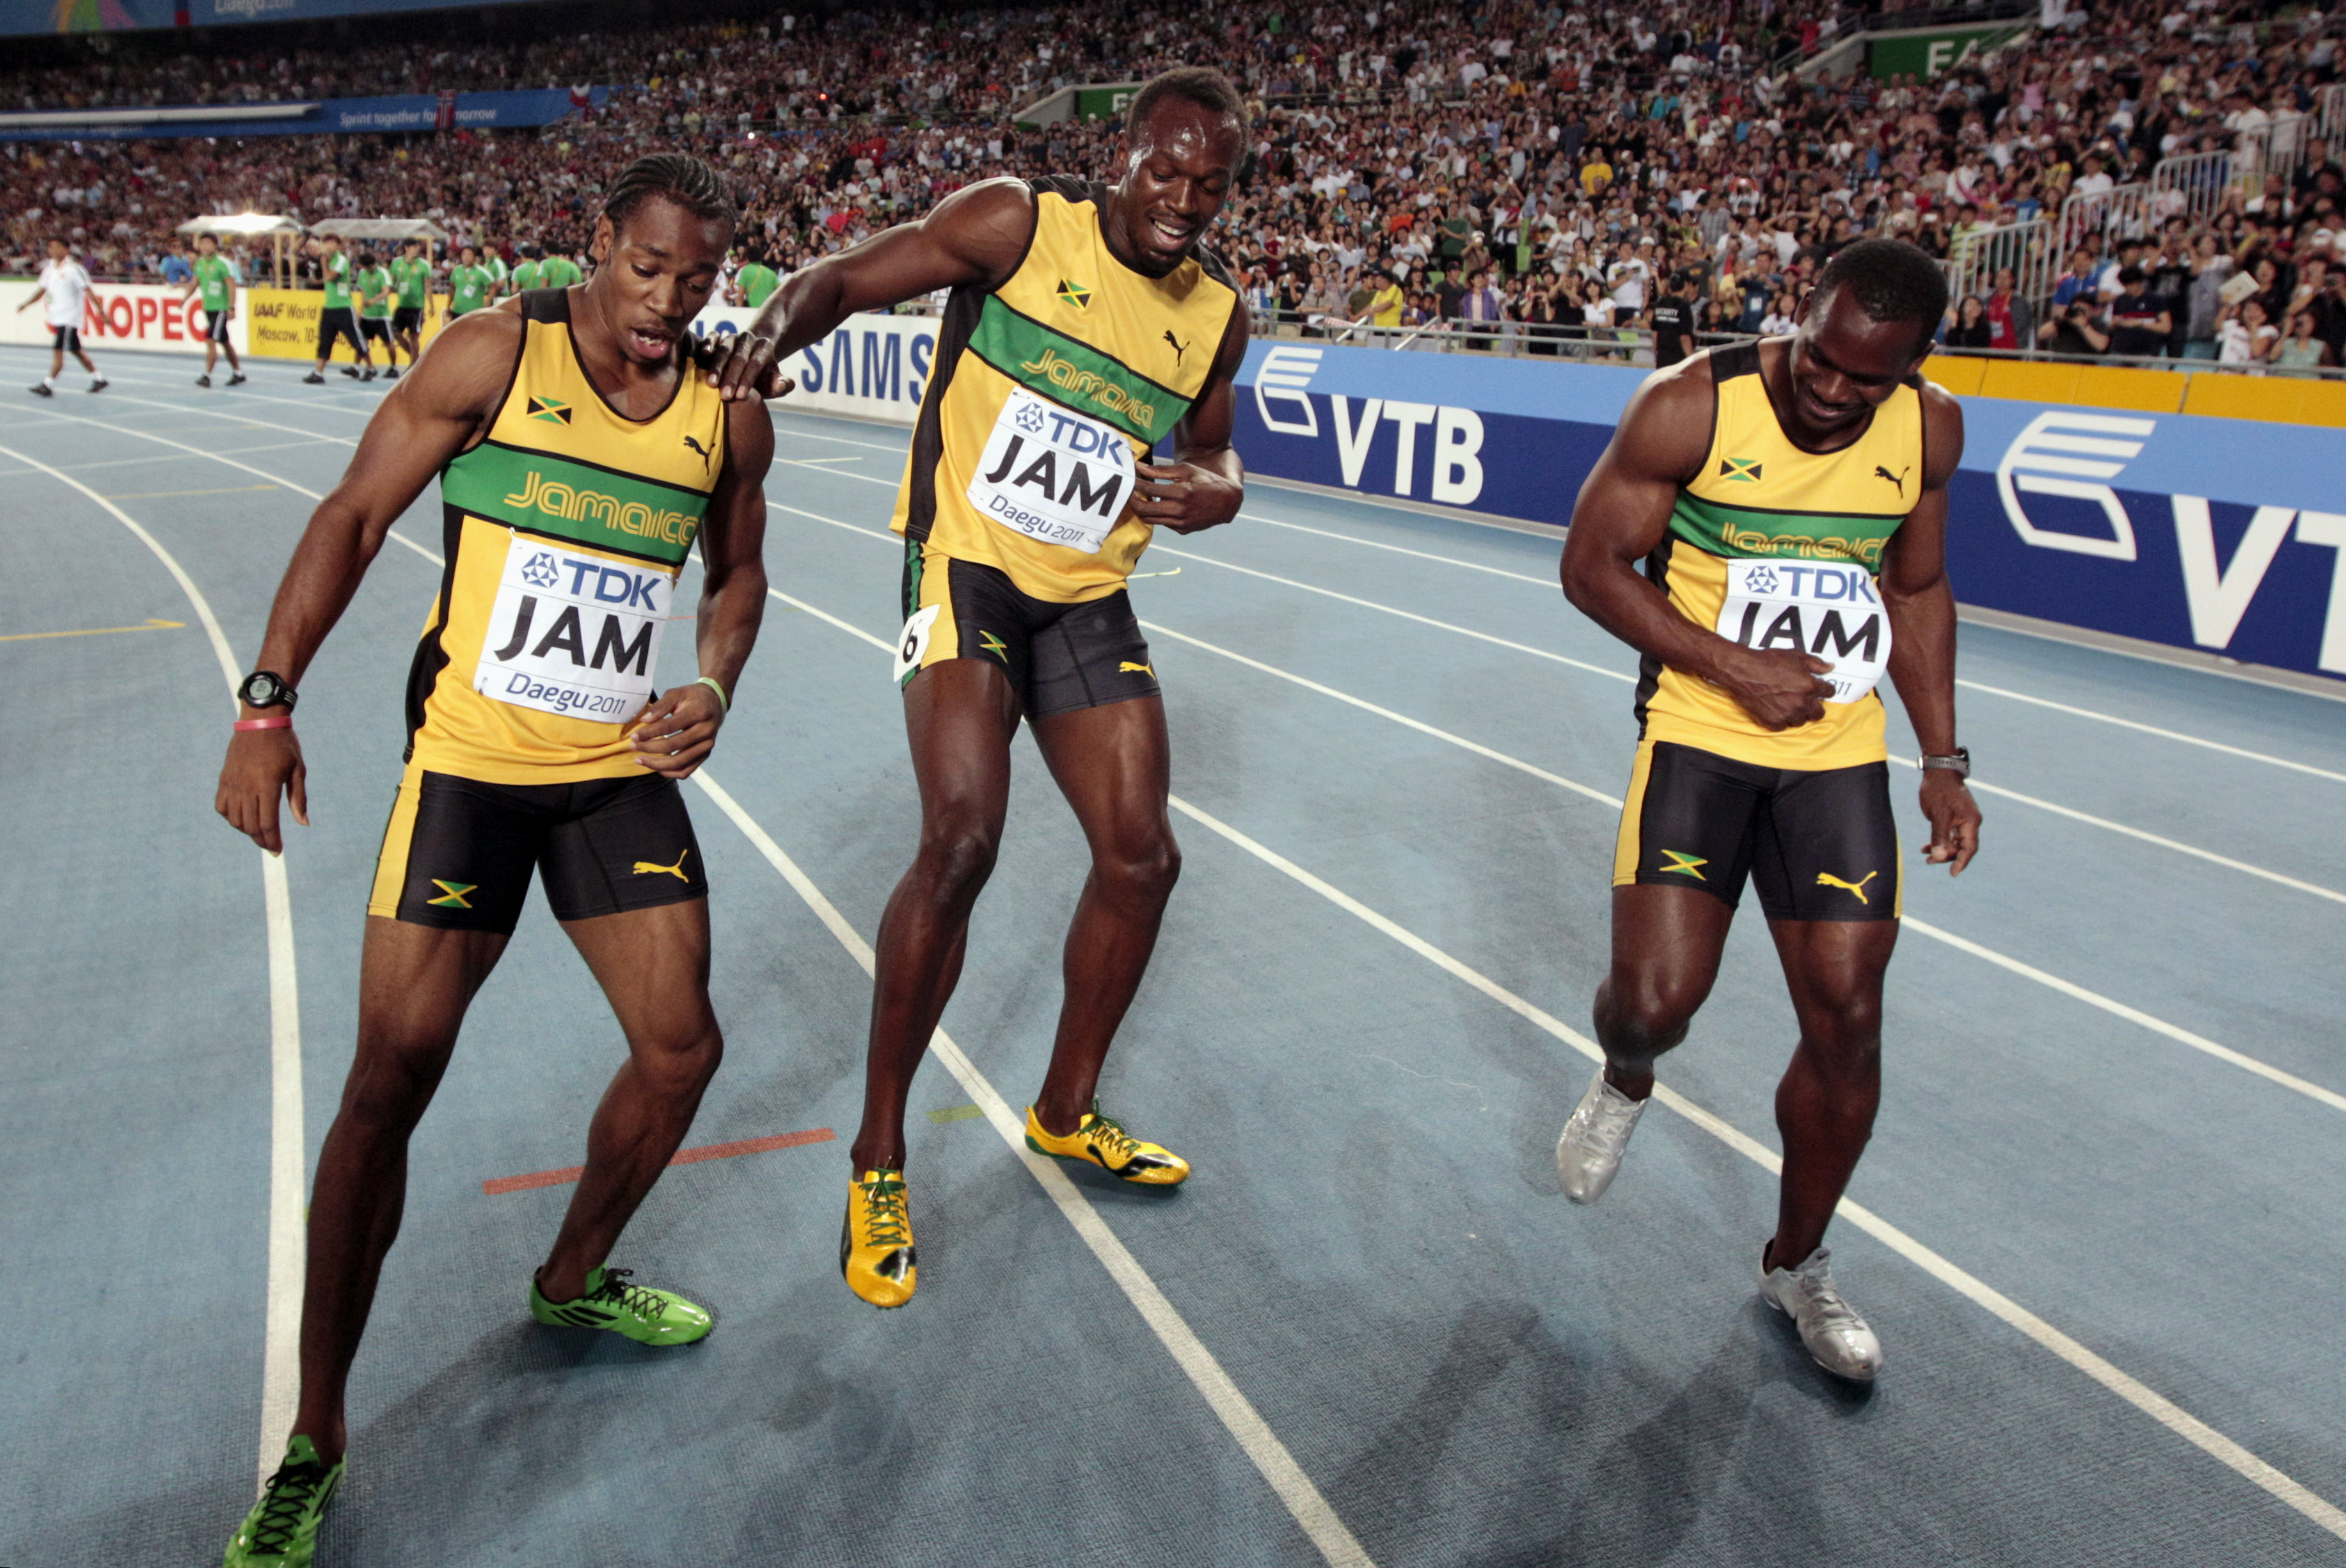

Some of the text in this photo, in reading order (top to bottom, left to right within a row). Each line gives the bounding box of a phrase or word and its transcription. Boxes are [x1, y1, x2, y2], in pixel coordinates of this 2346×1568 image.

[340, 112, 371, 127] Sprint
[374, 109, 420, 127] together
[455, 109, 497, 122] morrow
[44, 295, 207, 342] NOPEC
[253, 303, 317, 320] IAAF World
[257, 326, 300, 344] Moscow,
[1020, 347, 1155, 431] Jamaica
[1048, 411, 1124, 468] TDK
[1331, 393, 1484, 505] VTB
[985, 433, 1123, 518] JAM
[503, 471, 699, 547] Jamaica
[562, 557, 662, 612] TDK
[1778, 566, 1878, 604] TDK
[493, 594, 654, 677] JAM
[903, 619, 923, 663] 6
